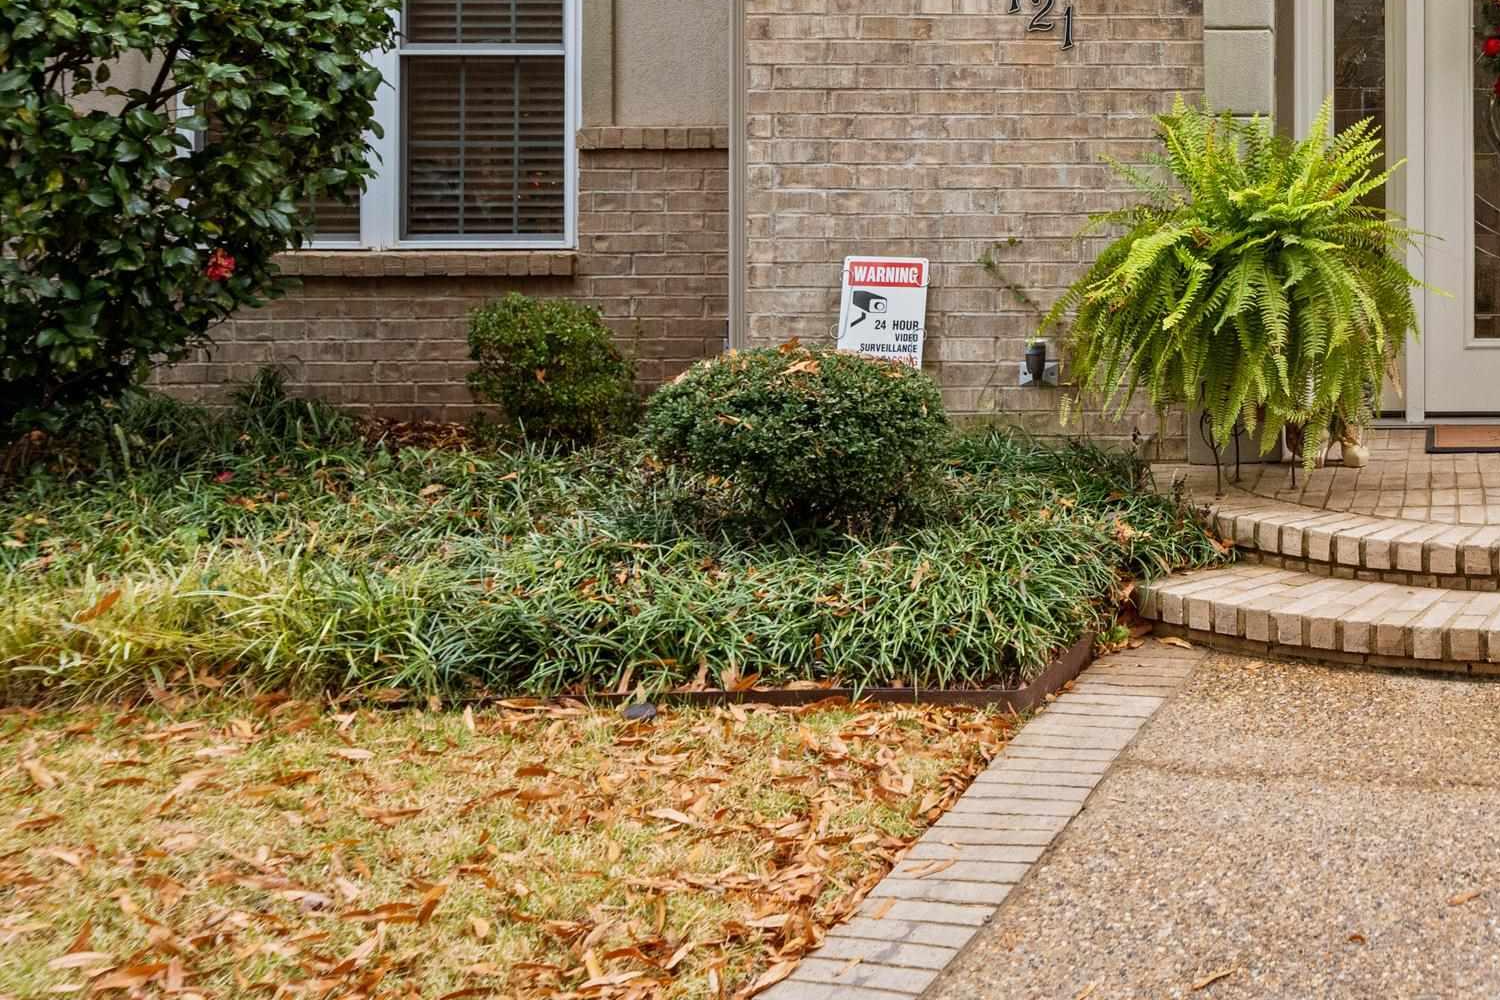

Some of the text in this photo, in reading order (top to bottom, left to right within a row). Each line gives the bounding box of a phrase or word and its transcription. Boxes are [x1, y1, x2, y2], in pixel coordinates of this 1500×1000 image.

[854, 265, 918, 283] WARNING
[874, 319, 919, 331] 24 HOUR
[895, 333, 919, 342] VIDEO
[860, 343, 918, 353] SURVEILLANCE
